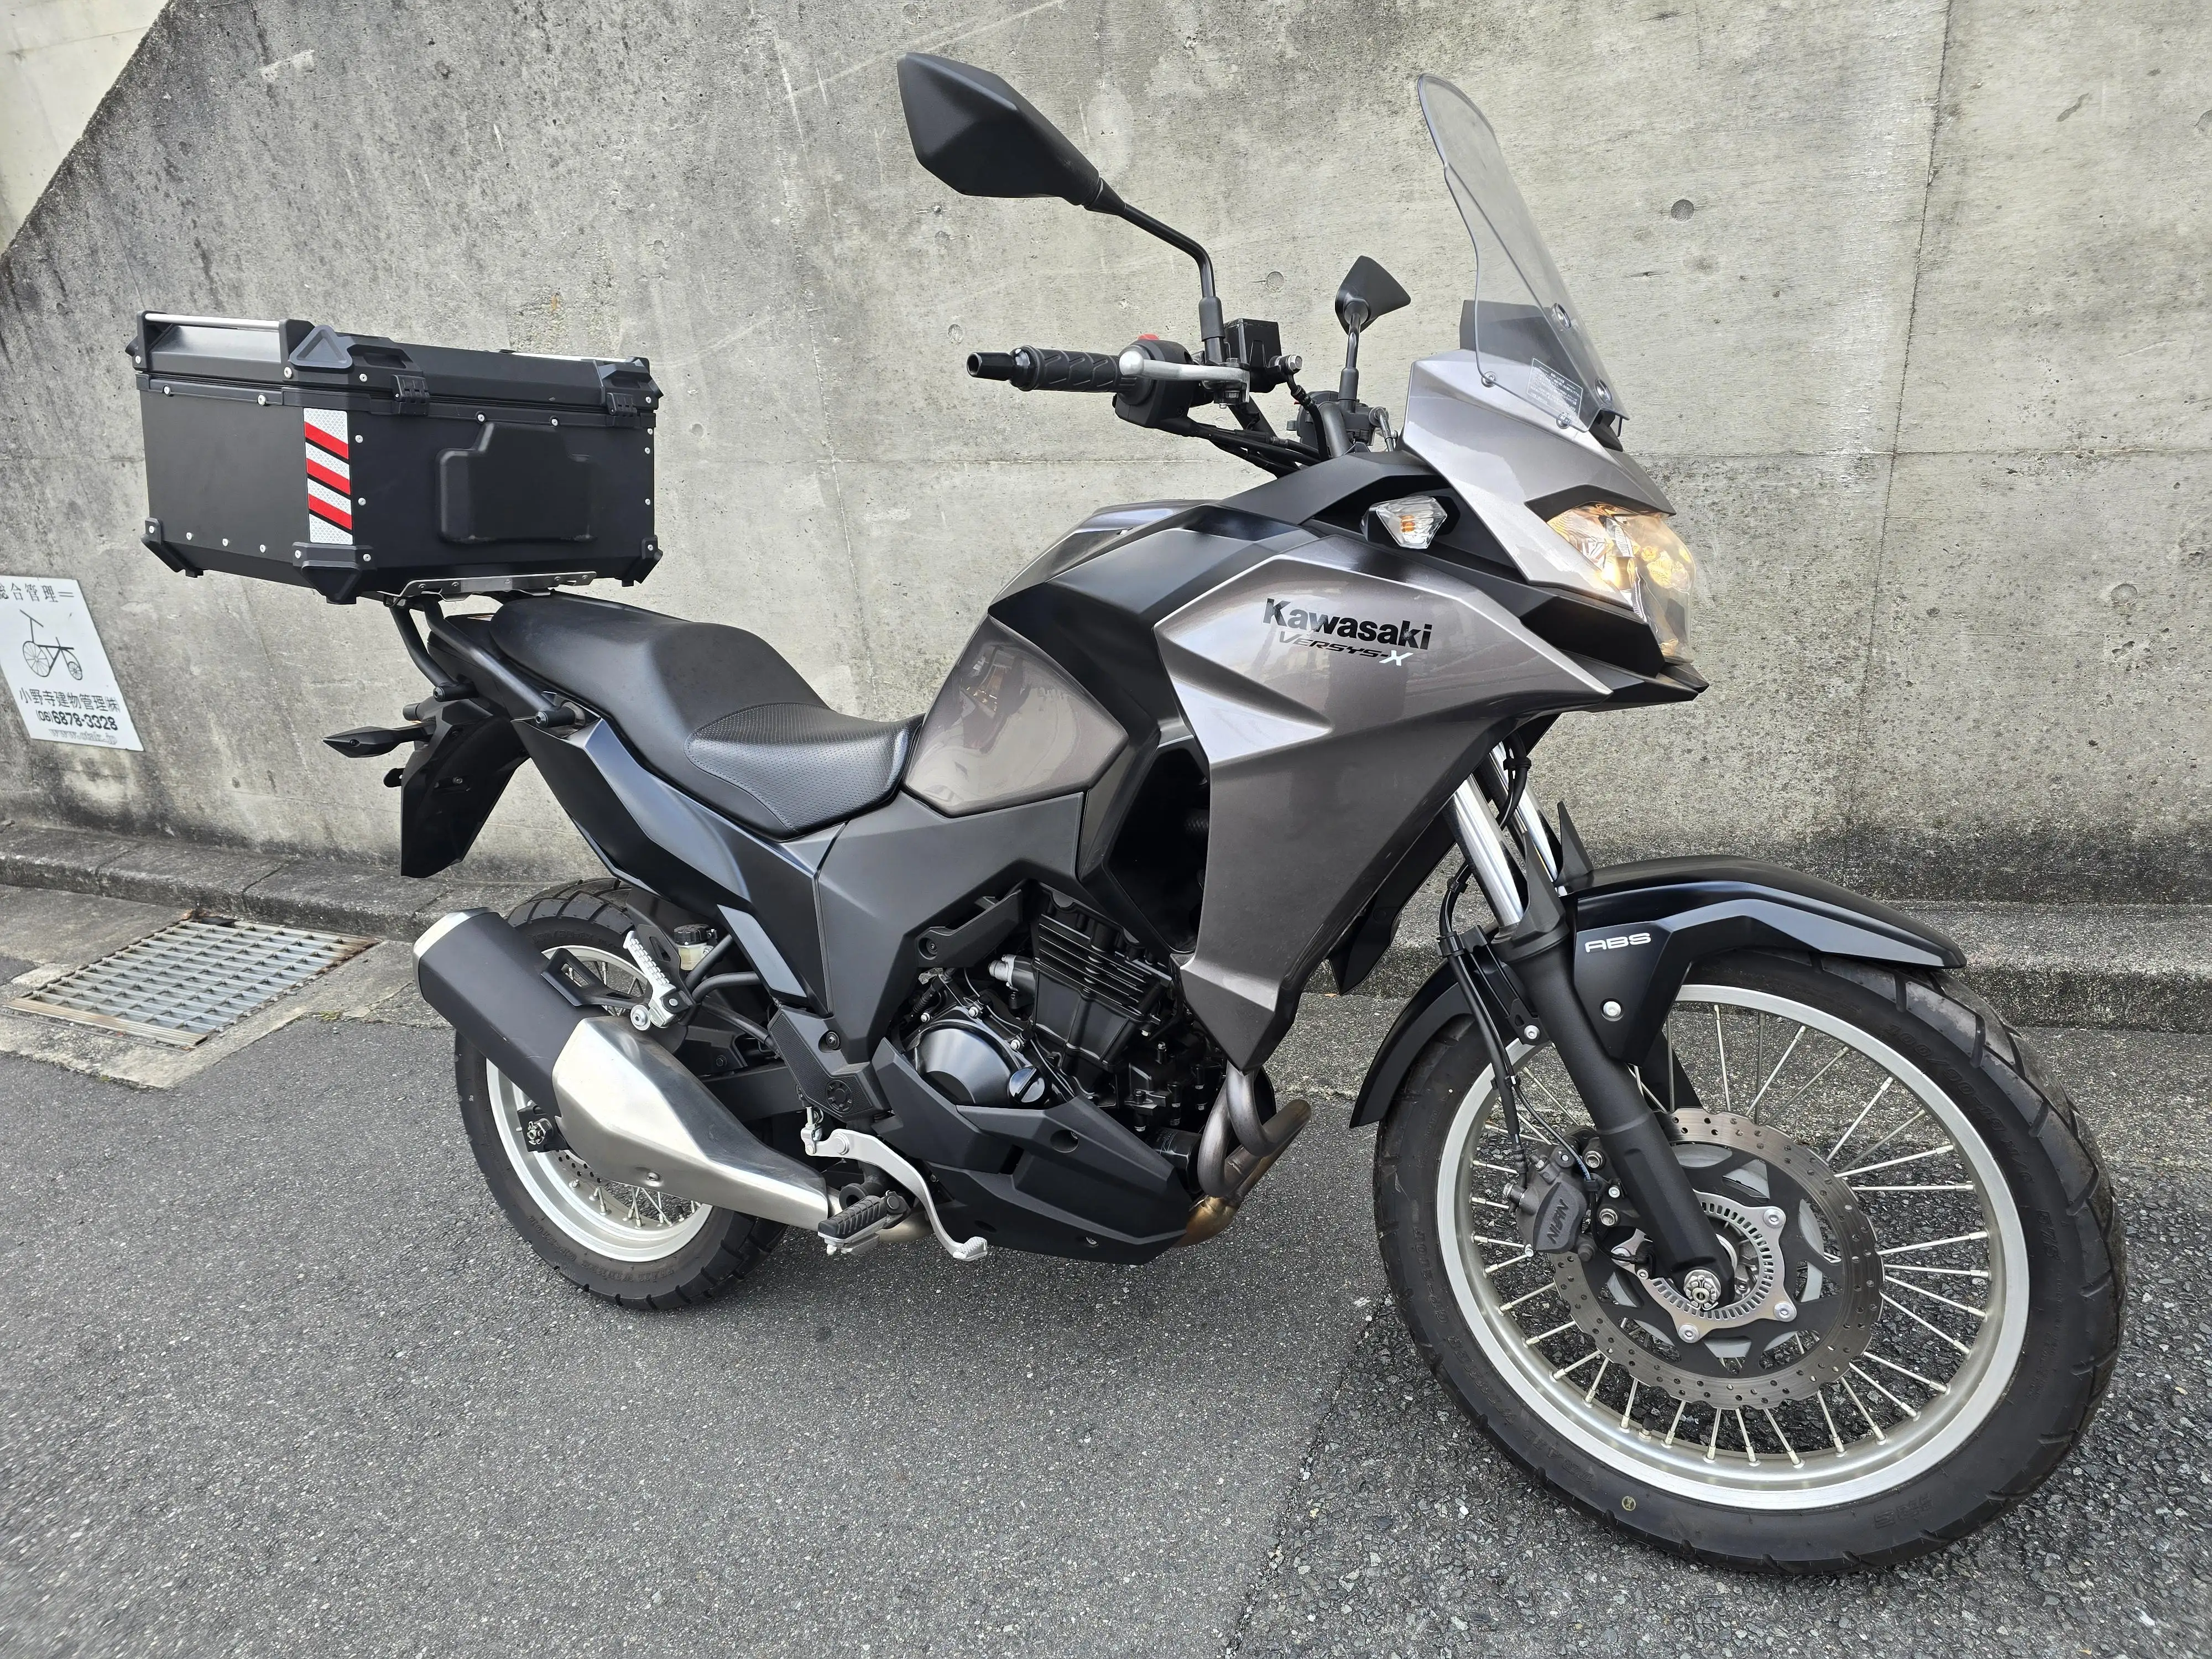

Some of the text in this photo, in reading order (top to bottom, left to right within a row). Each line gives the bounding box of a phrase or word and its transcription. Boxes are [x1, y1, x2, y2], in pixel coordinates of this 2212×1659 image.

[1262, 598, 1433, 650] Kawasaki
[1279, 630, 1413, 666] VERSYS-X
[1584, 932, 1651, 953] ABS
[1885, 1022, 2008, 1133] 100/90-19
[1447, 1335, 1517, 1425] WINNER
[1521, 1428, 1595, 1486] TRAIL
